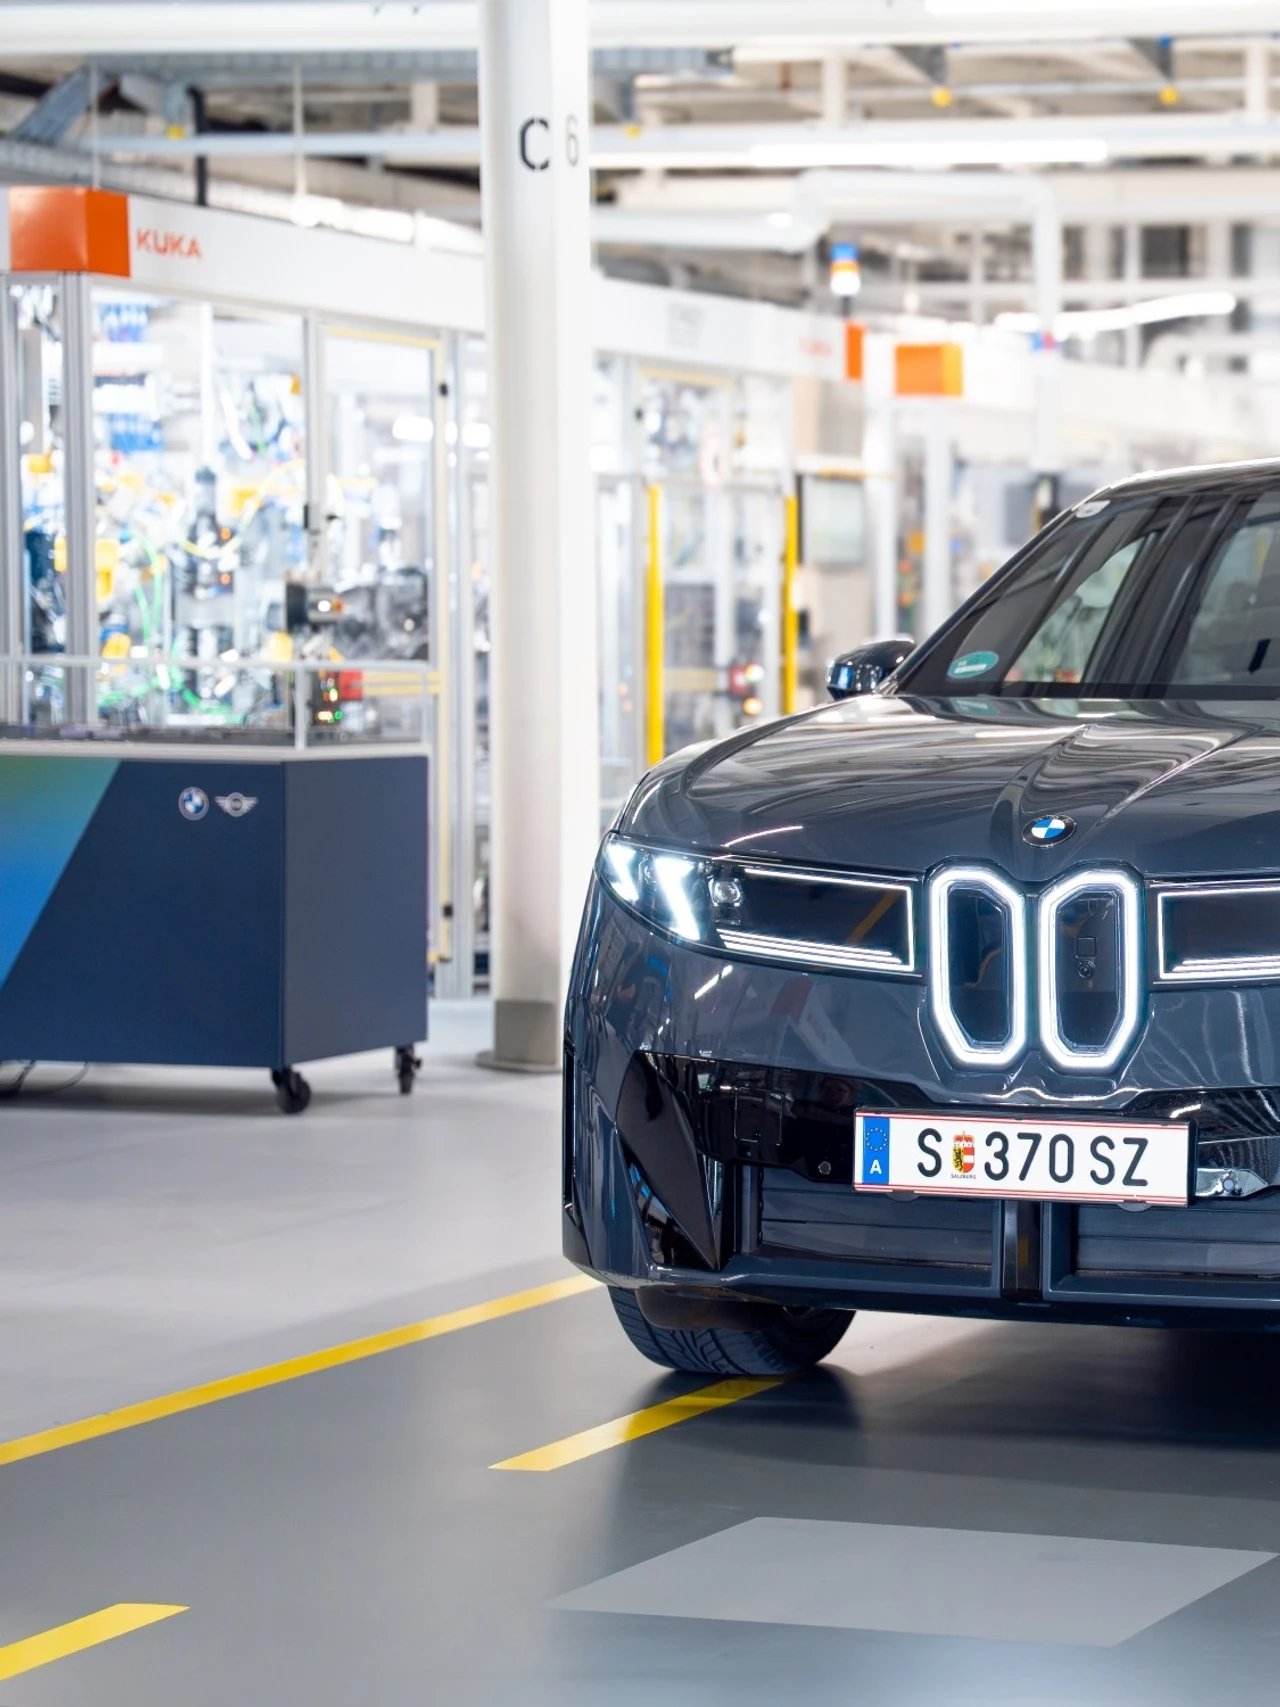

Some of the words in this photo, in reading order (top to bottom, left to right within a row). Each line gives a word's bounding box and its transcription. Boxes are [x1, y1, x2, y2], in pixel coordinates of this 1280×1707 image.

[519, 117, 549, 171] C
[566, 114, 579, 168] 6
[136, 227, 203, 262] KUKA
[869, 1159, 882, 1175] A
[917, 1127, 942, 1178] S
[984, 1131, 1075, 1184] 370
[1089, 1135, 1149, 1187] SZ
